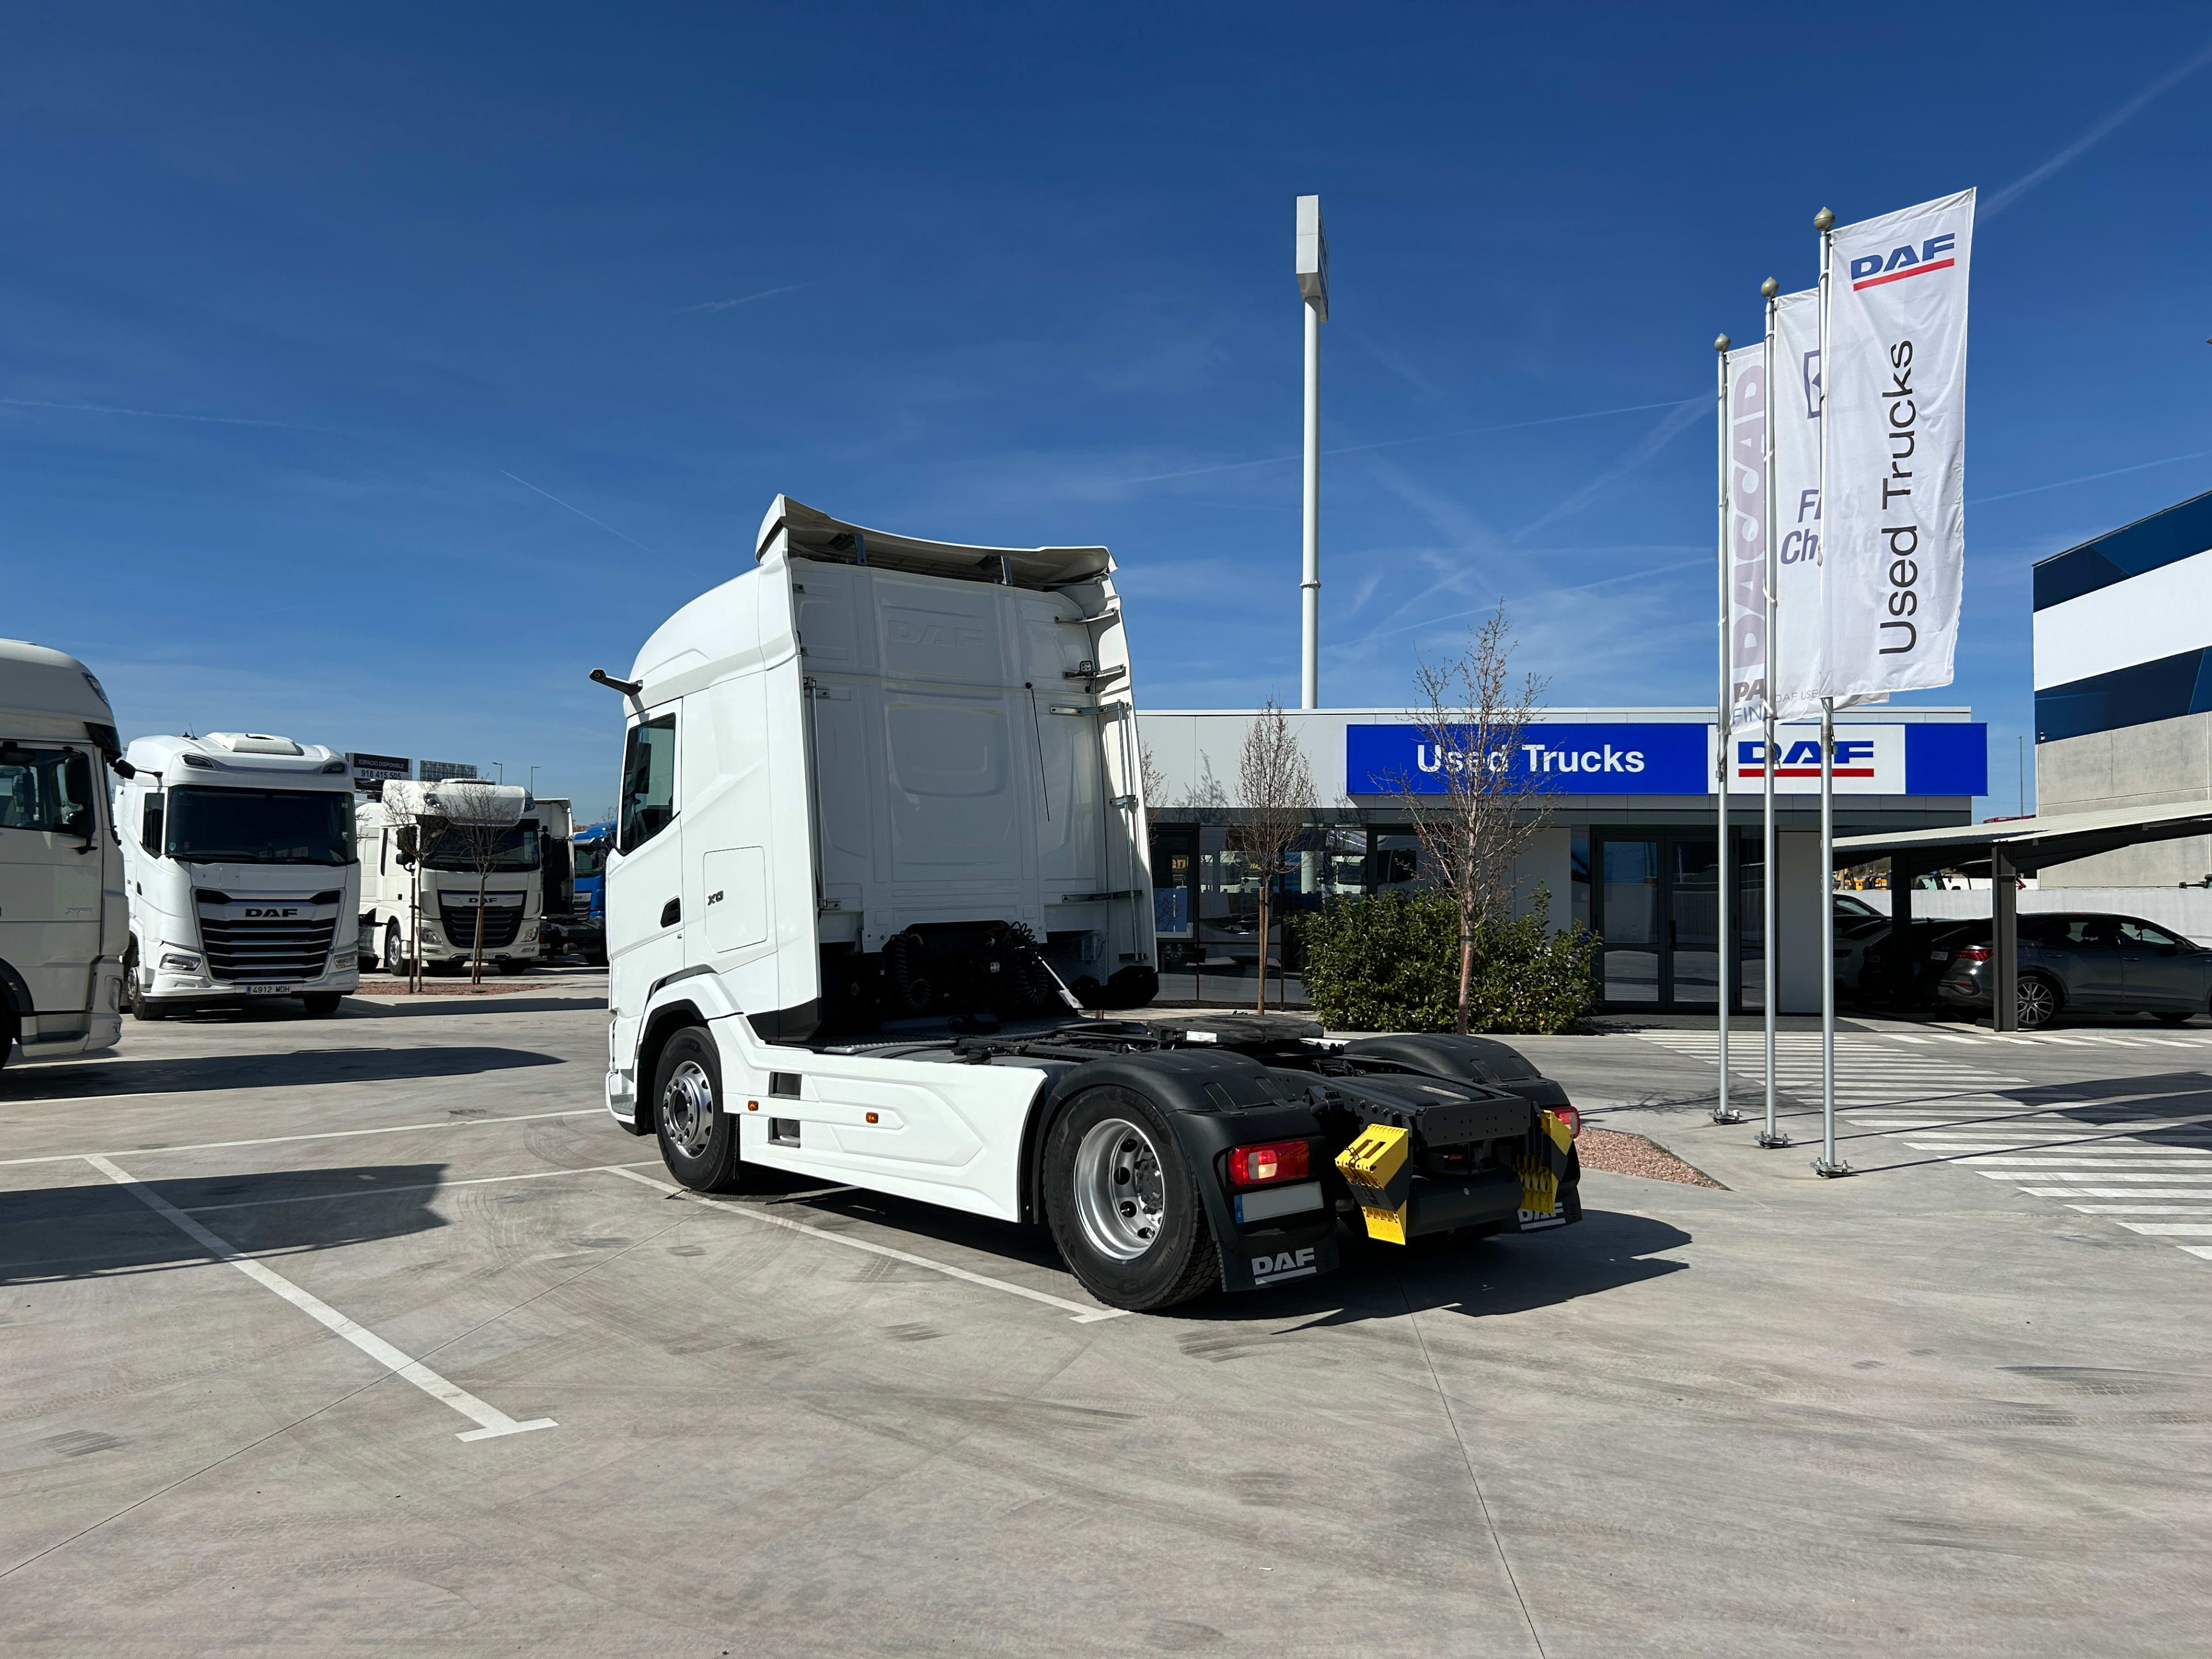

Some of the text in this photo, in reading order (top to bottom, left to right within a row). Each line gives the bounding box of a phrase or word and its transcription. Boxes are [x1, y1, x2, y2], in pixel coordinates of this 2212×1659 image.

[1851, 233, 1955, 281] DAF
[1879, 339, 1918, 655] Used Trucks
[888, 620, 985, 649] DAF
[1801, 689, 1819, 700] USE
[1418, 744, 1645, 772] Used Trucks
[1738, 741, 1874, 764] DAF
[361, 769, 374, 778] 918
[376, 771, 388, 779] 415
[245, 908, 298, 917] DAF
[253, 986, 272, 994] 4912
[1517, 1202, 1564, 1223] DAF
[1251, 1247, 1315, 1276] DAF
